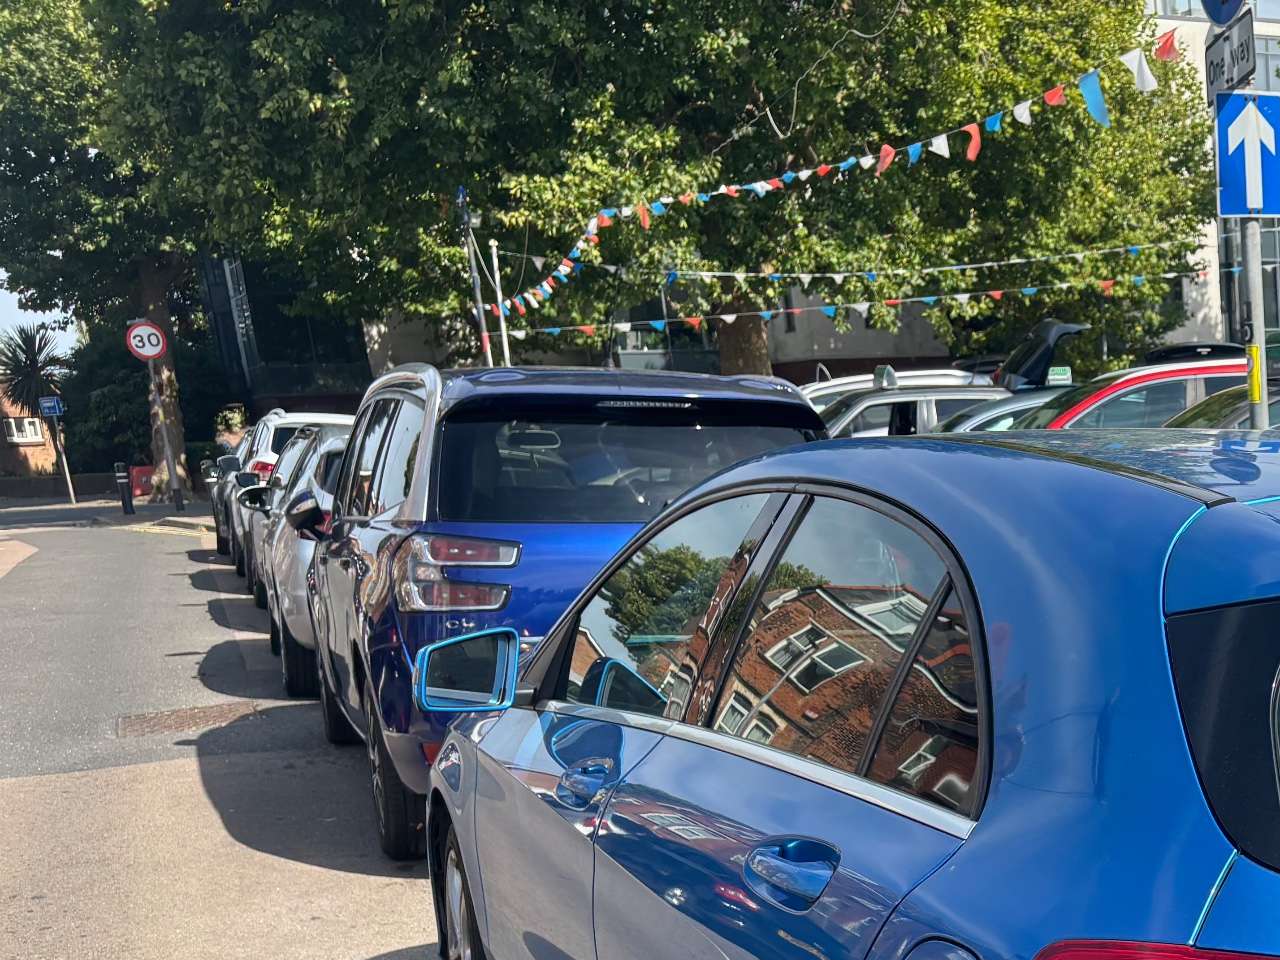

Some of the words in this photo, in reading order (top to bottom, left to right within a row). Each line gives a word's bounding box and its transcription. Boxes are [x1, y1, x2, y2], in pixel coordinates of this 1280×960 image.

[1209, 58, 1225, 86] One
[132, 333, 161, 349] 30
[446, 618, 475, 632] C4
